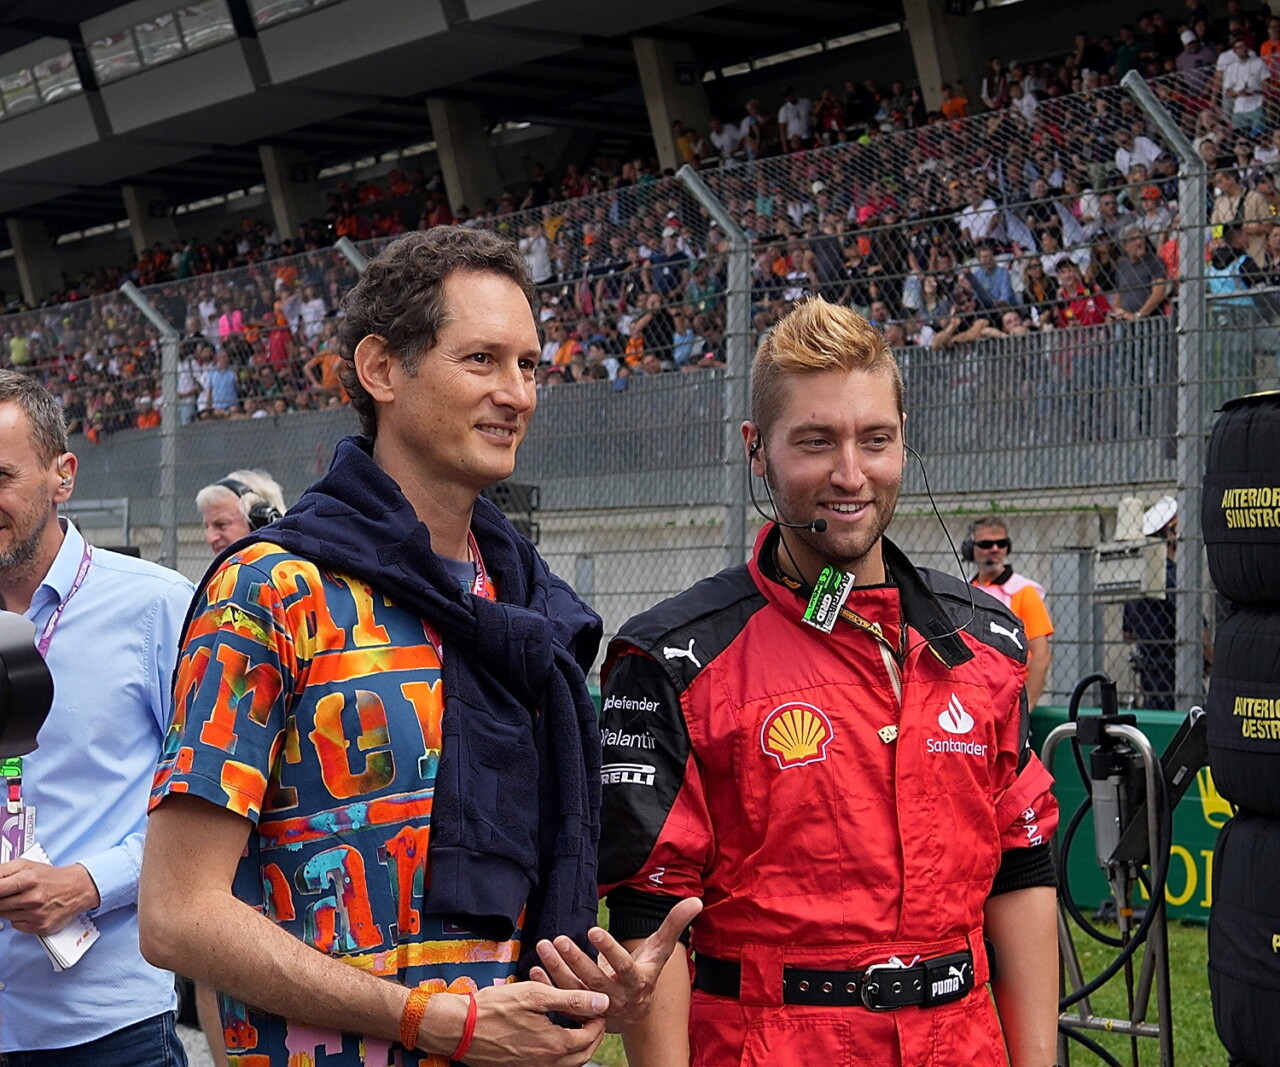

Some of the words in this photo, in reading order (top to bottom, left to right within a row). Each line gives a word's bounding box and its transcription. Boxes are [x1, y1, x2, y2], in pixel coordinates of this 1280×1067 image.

[926, 738, 988, 756] Santander
[26, 812, 35, 845] MEDIA
[932, 976, 959, 998] PUMA
